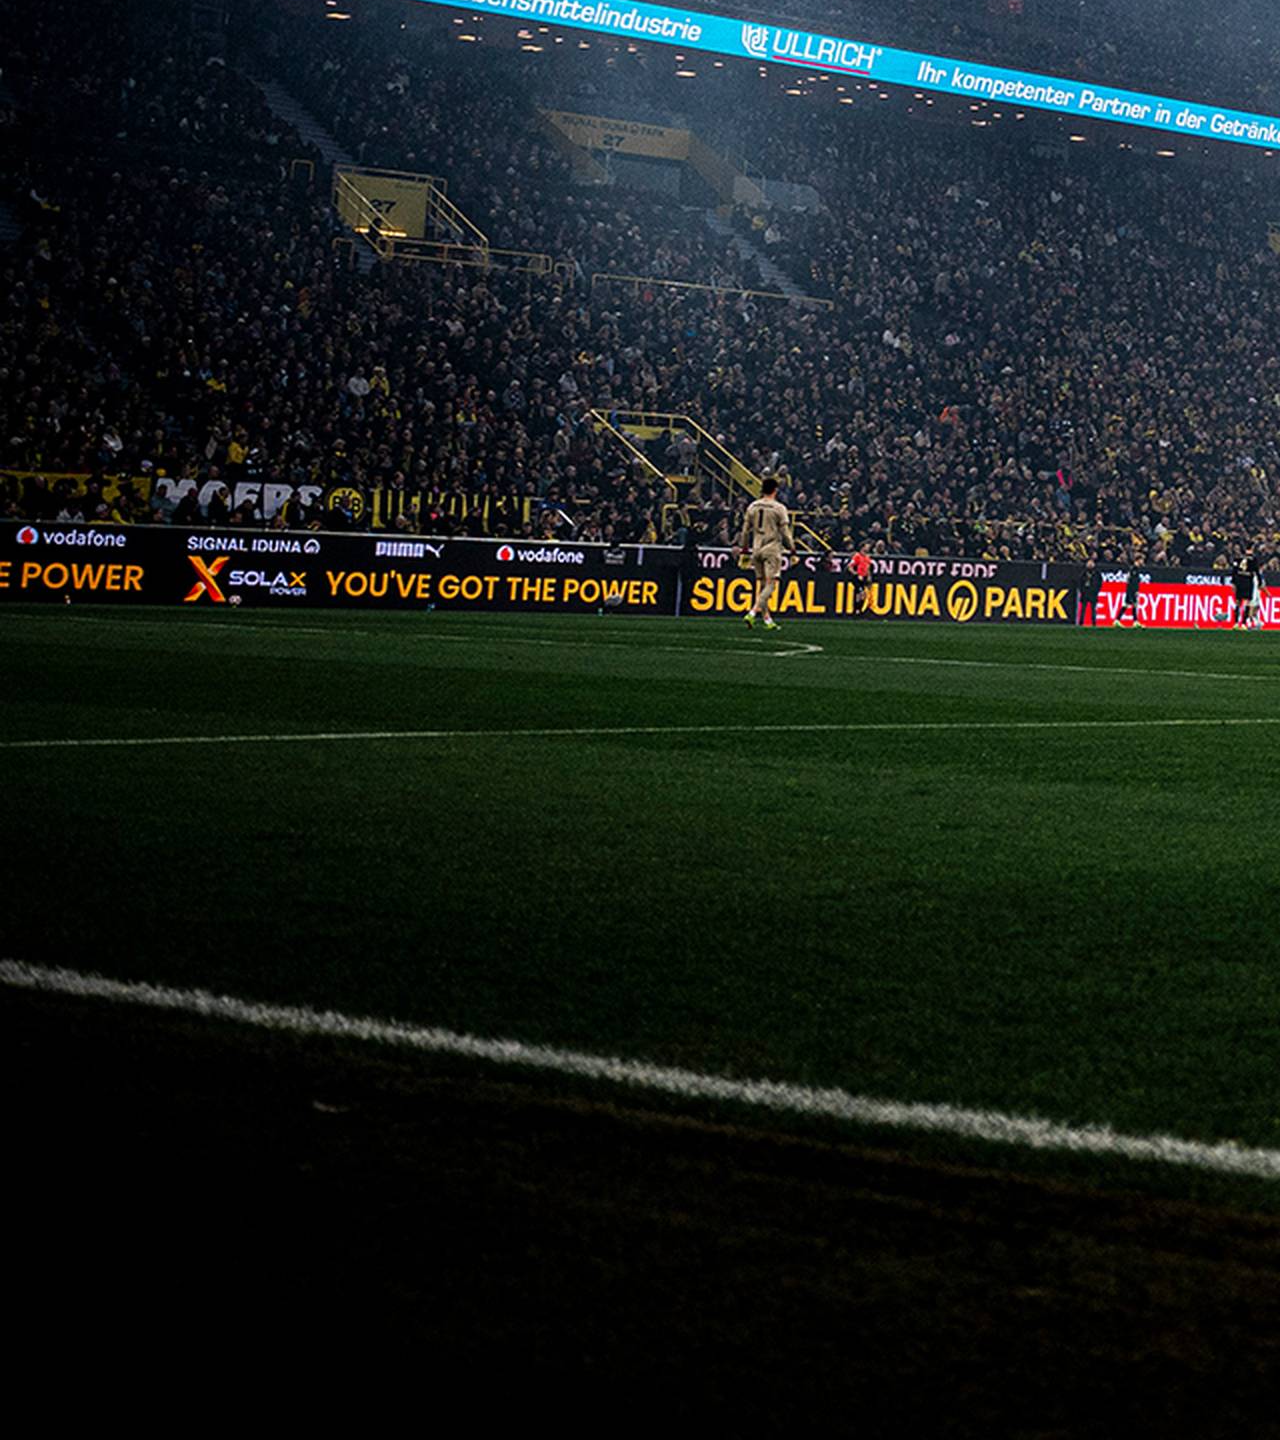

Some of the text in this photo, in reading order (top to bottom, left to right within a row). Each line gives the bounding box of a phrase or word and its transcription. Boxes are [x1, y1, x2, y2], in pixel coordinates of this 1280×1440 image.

[772, 29, 875, 69] ULLRICH
[917, 61, 947, 85] Ihr
[952, 62, 1074, 107] kompetenter
[1079, 89, 1151, 121] Partner
[1155, 103, 1172, 124] in
[1176, 109, 1206, 131] der
[603, 133, 625, 148] 27
[757, 509, 765, 535] 1
[43, 530, 126, 547] vodafone
[187, 536, 301, 553] SIGNAL IDUNA
[517, 549, 585, 565] vodafone
[21, 562, 145, 591] POWER
[228, 570, 306, 587] SOLAX
[325, 569, 659, 605] YOU'VE GOT THE POWER
[985, 587, 1069, 621] PARK
